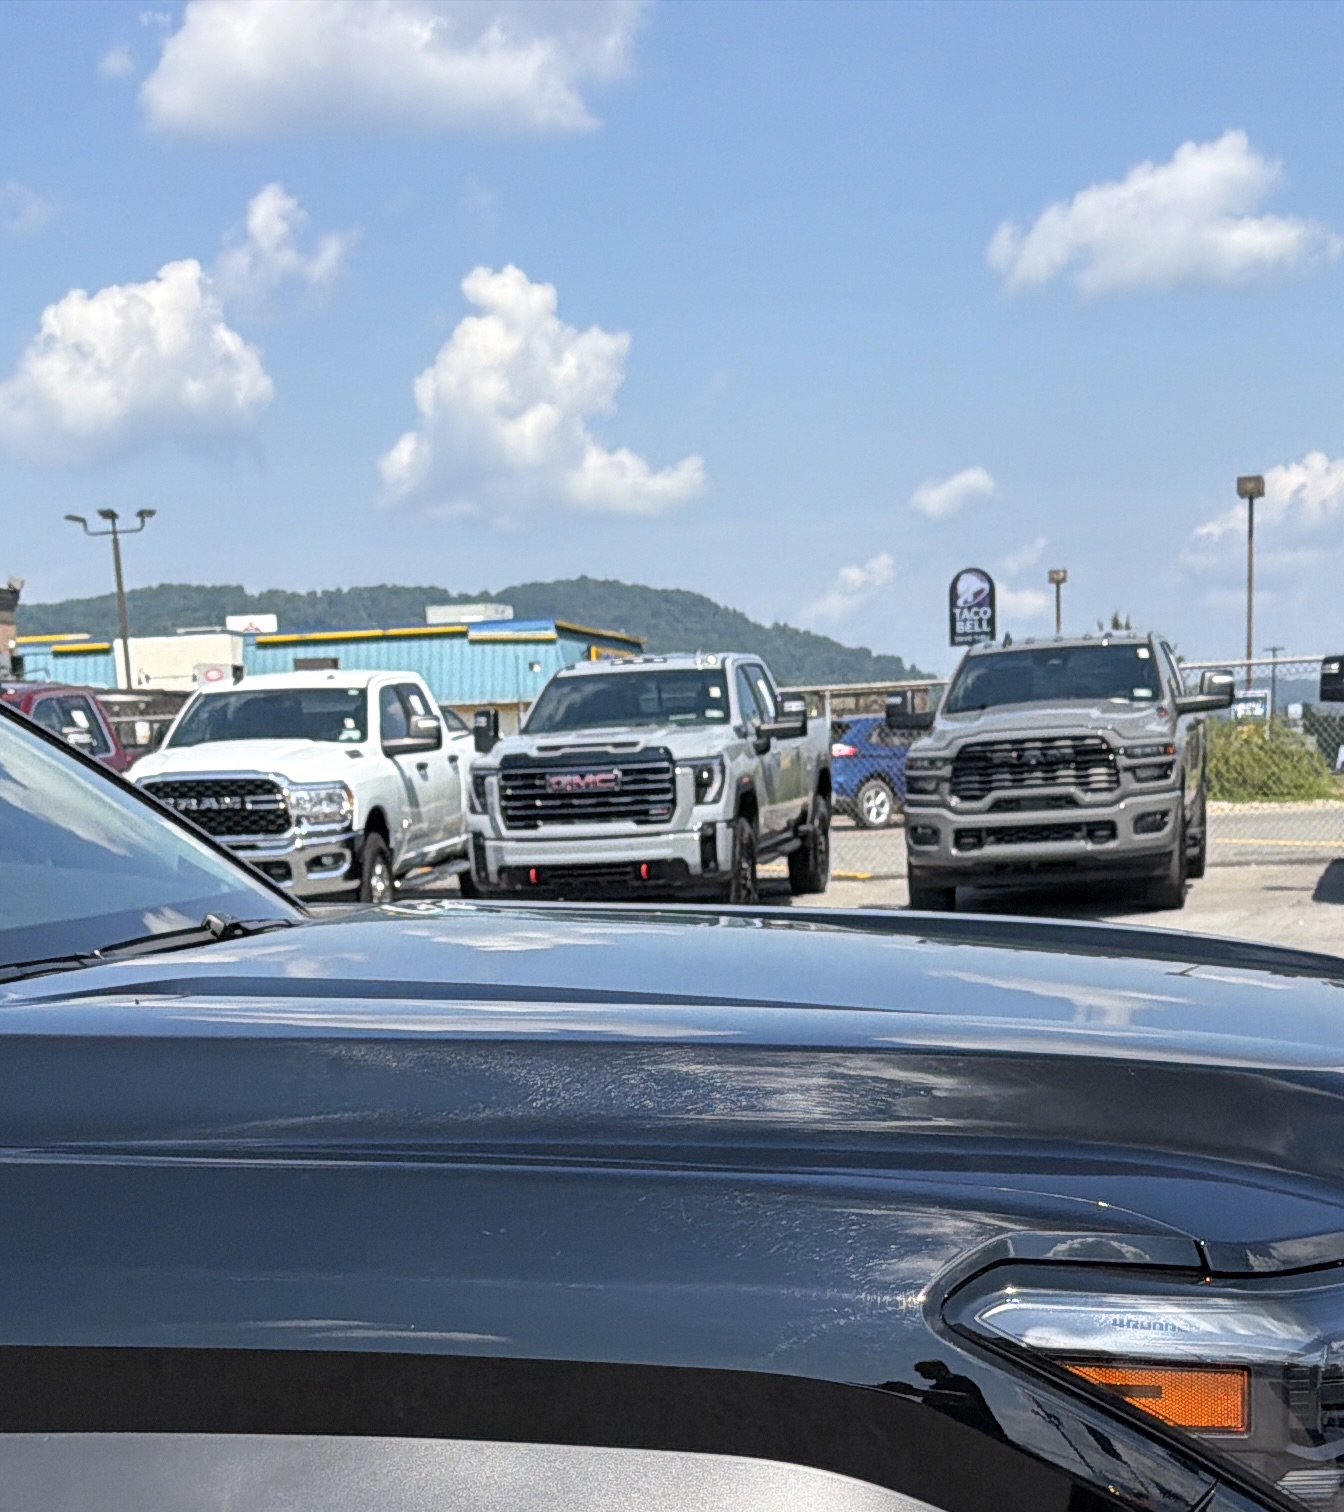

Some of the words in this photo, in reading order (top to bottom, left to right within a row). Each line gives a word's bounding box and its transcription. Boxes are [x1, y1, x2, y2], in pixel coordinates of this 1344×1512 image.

[953, 606, 992, 620] TACO
[955, 619, 992, 633] BELL
[547, 773, 619, 792] GMC
